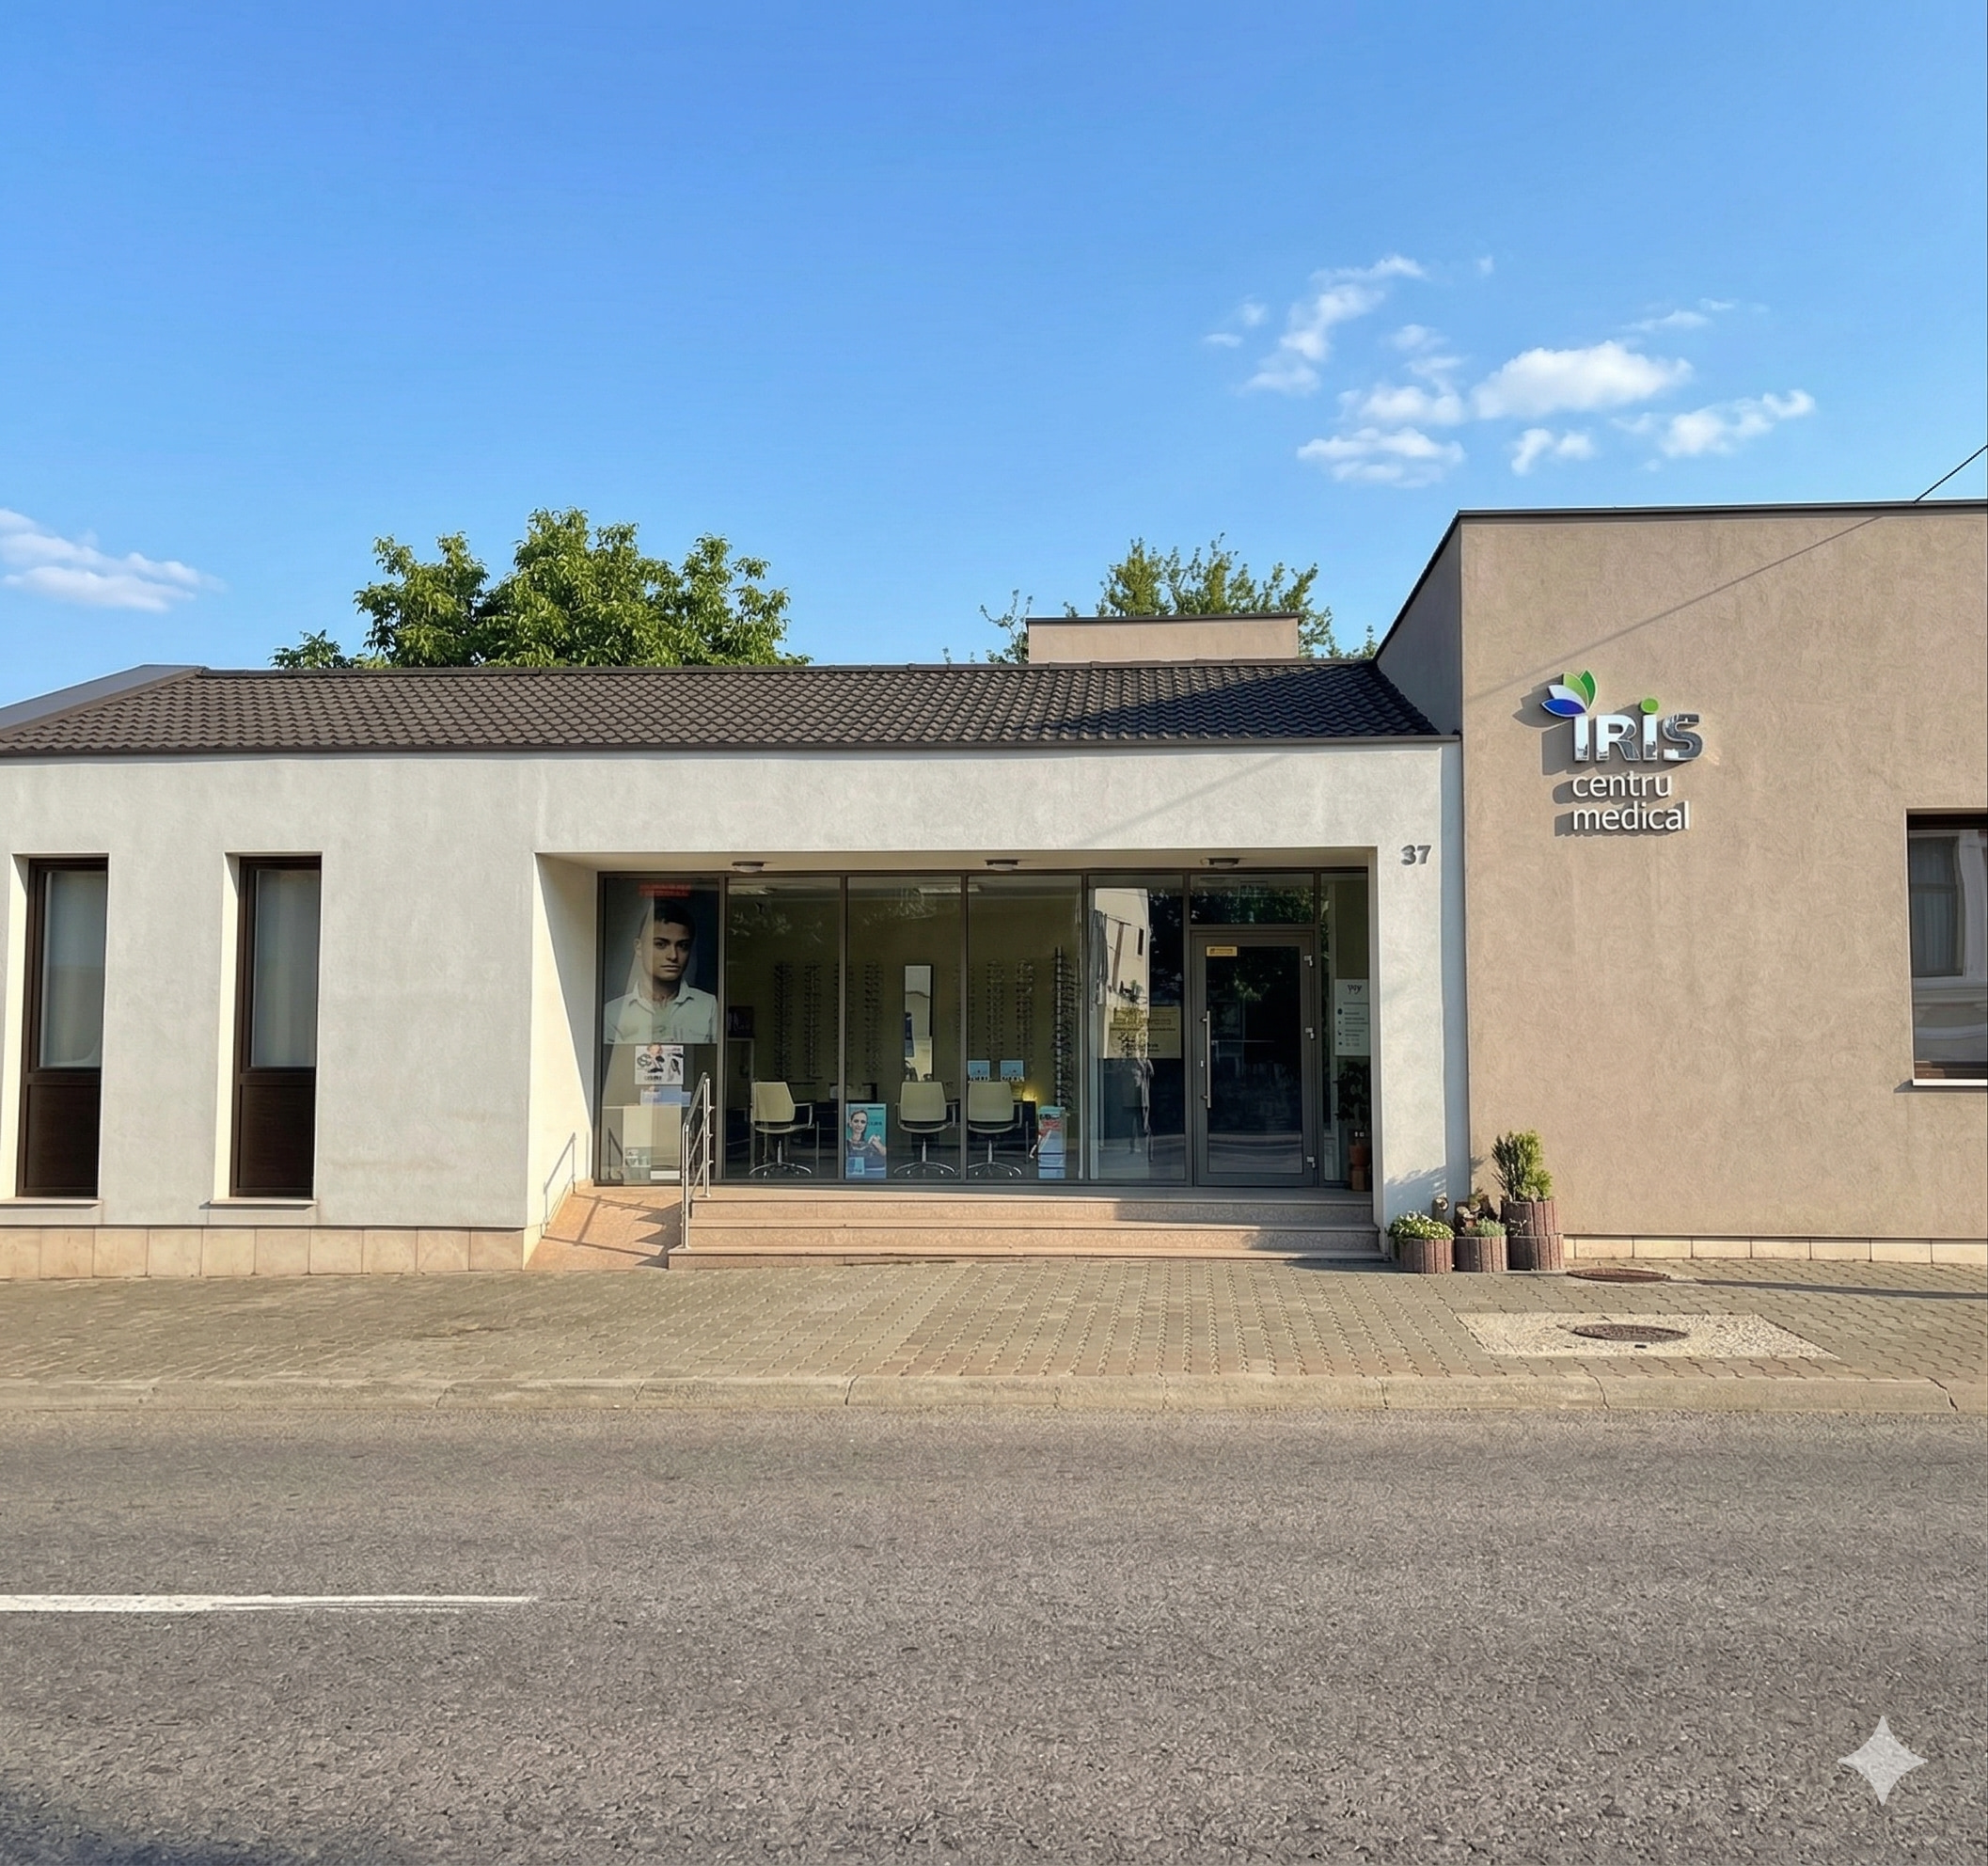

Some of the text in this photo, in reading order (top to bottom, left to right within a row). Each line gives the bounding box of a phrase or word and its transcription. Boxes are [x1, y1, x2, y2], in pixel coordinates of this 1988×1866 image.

[1571, 771, 1672, 798] centru
[1572, 800, 1691, 830] medical
[1401, 845, 1431, 865] 37
